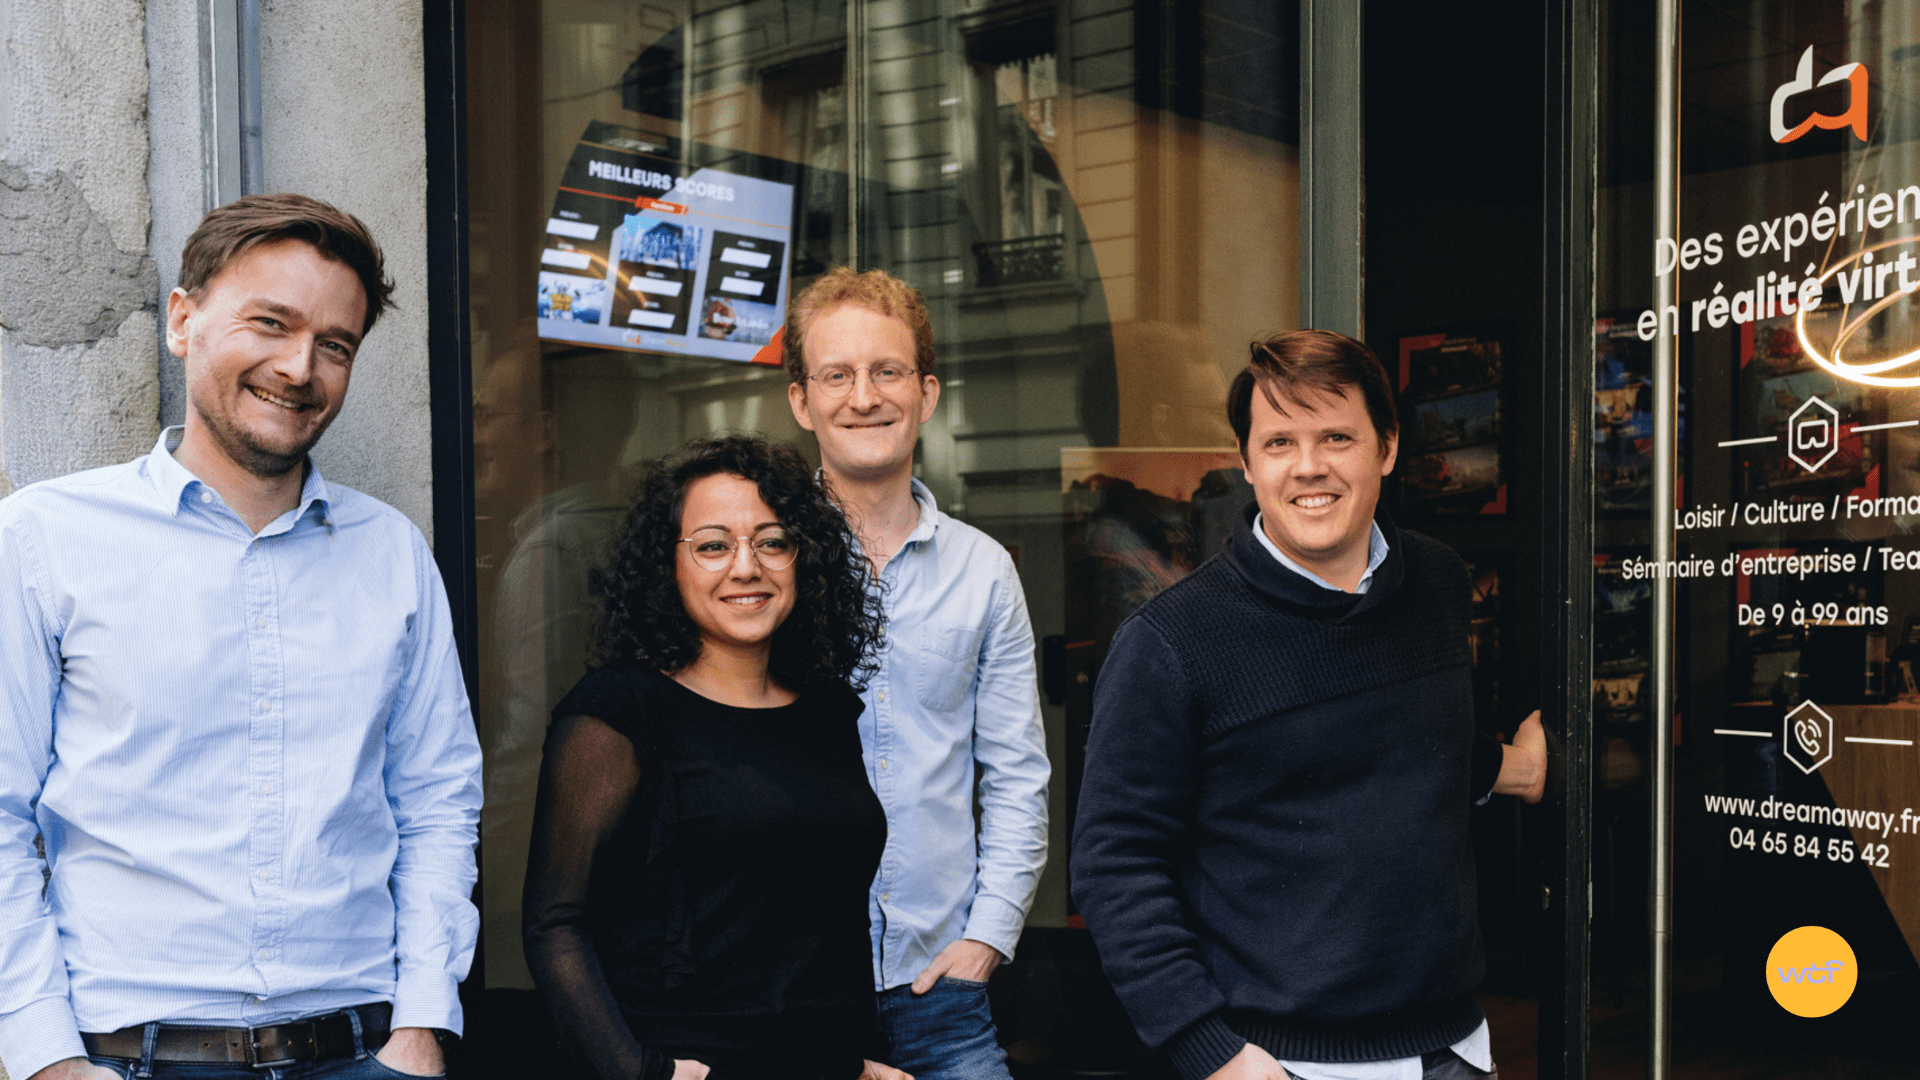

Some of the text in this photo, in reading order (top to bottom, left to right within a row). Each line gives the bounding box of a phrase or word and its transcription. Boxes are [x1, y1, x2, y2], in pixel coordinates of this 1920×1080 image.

[588, 160, 735, 201] MEILLEURS SCORES
[1655, 184, 1920, 277] Des expérien
[1637, 251, 1918, 341] en réalité virt
[1674, 504, 1726, 530] Loisir
[1744, 499, 1825, 526] Culture
[1622, 554, 1715, 580] Séminaire
[1738, 599, 1889, 626] De 9 à 99 ans
[1704, 795, 1920, 839] www.dreamaway.fr
[1729, 826, 1890, 868] 04 65 84 55 42
